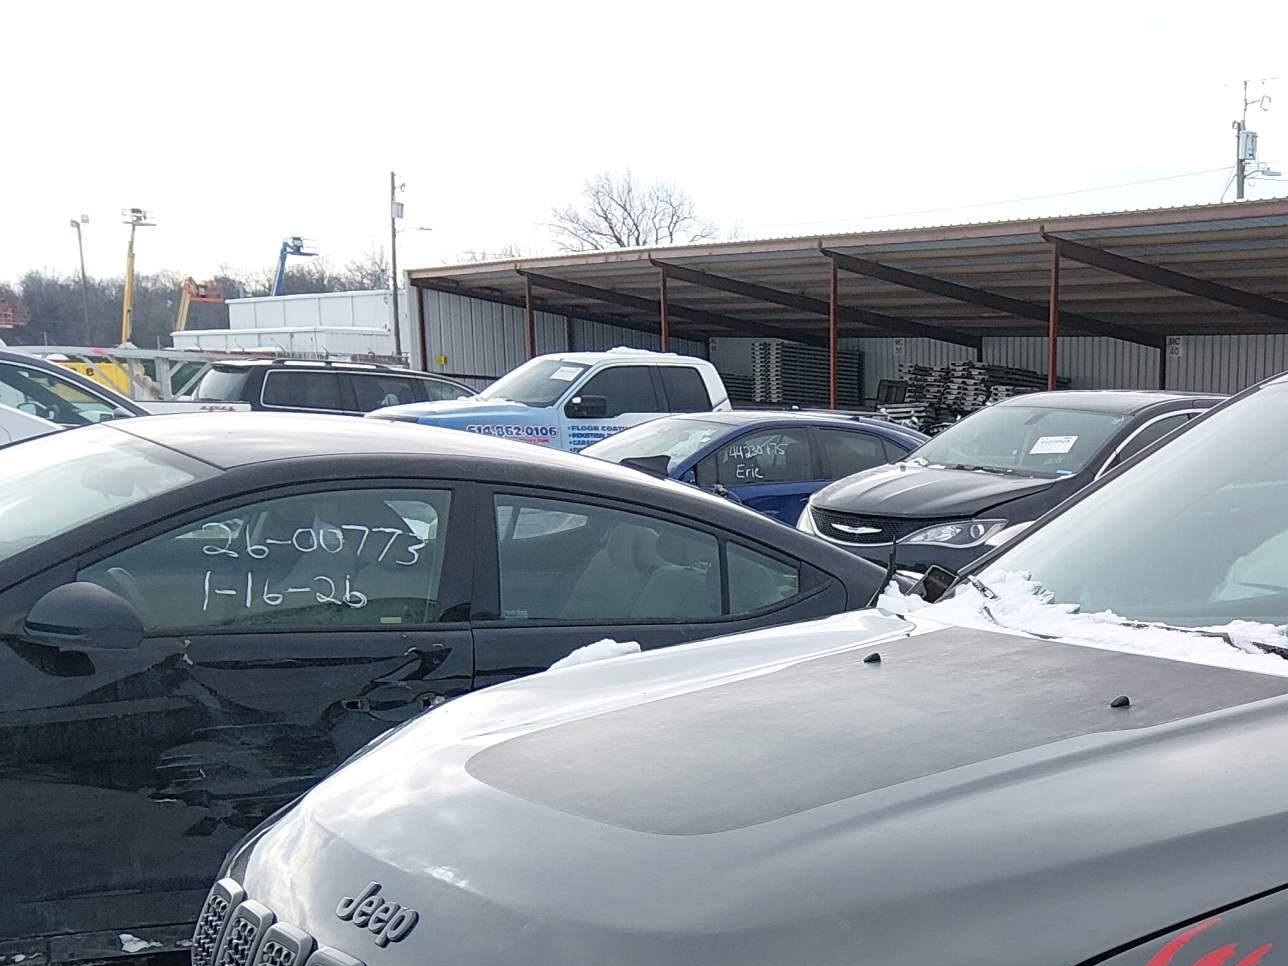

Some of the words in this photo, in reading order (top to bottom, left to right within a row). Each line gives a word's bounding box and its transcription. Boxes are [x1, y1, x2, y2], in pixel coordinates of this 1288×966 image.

[736, 464, 763, 478] Eric
[202, 523, 427, 566] 26-00773
[202, 571, 367, 610] 1-16-26
[336, 881, 419, 948] Jeep
